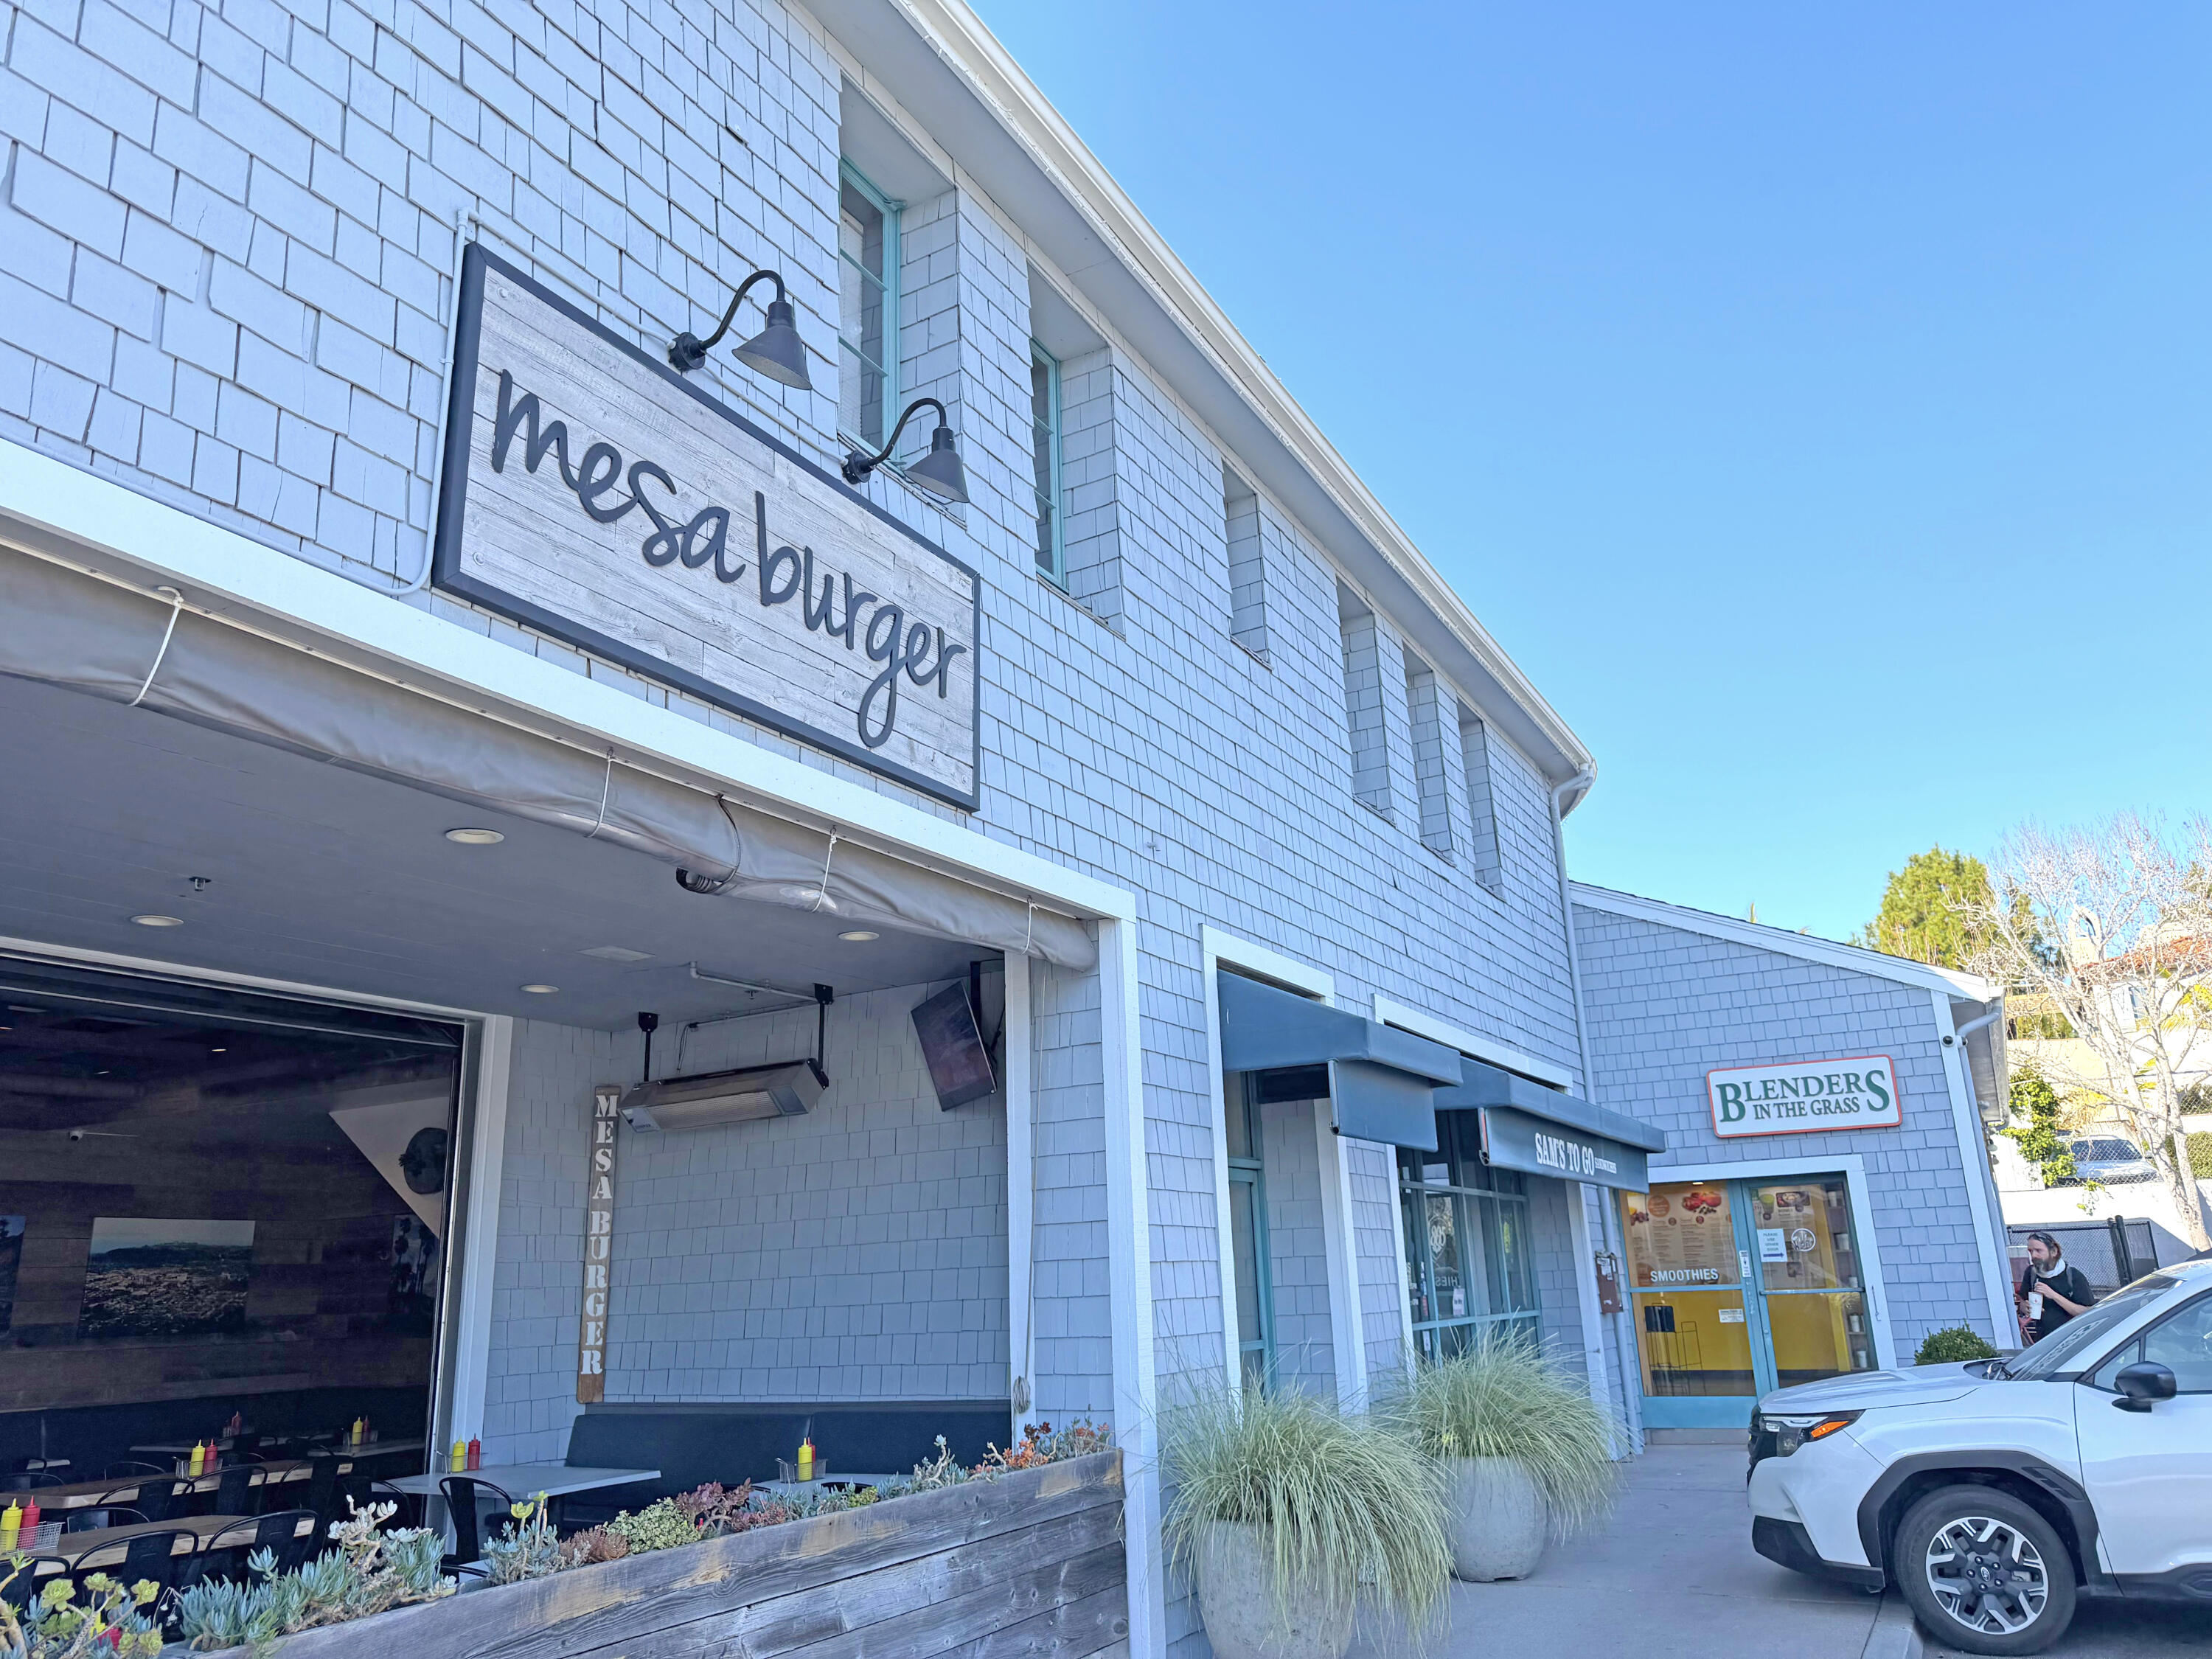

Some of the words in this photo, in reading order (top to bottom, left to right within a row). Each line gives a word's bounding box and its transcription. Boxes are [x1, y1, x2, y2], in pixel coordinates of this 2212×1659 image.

[491, 369, 746, 583] mesa
[755, 490, 967, 748] burger
[1715, 1069, 1890, 1122] BLENDERS
[1753, 1102, 1771, 1120] IN
[1773, 1100, 1808, 1119] THE
[1810, 1096, 1861, 1116] GRASS
[592, 1094, 619, 1200] MESA
[1535, 1132, 1566, 1171] SAM'S
[1567, 1141, 1581, 1173] TO
[1582, 1145, 1595, 1176] GO
[580, 1209, 611, 1376] BURGER
[1650, 1267, 1719, 1282] SMOOTHIES
